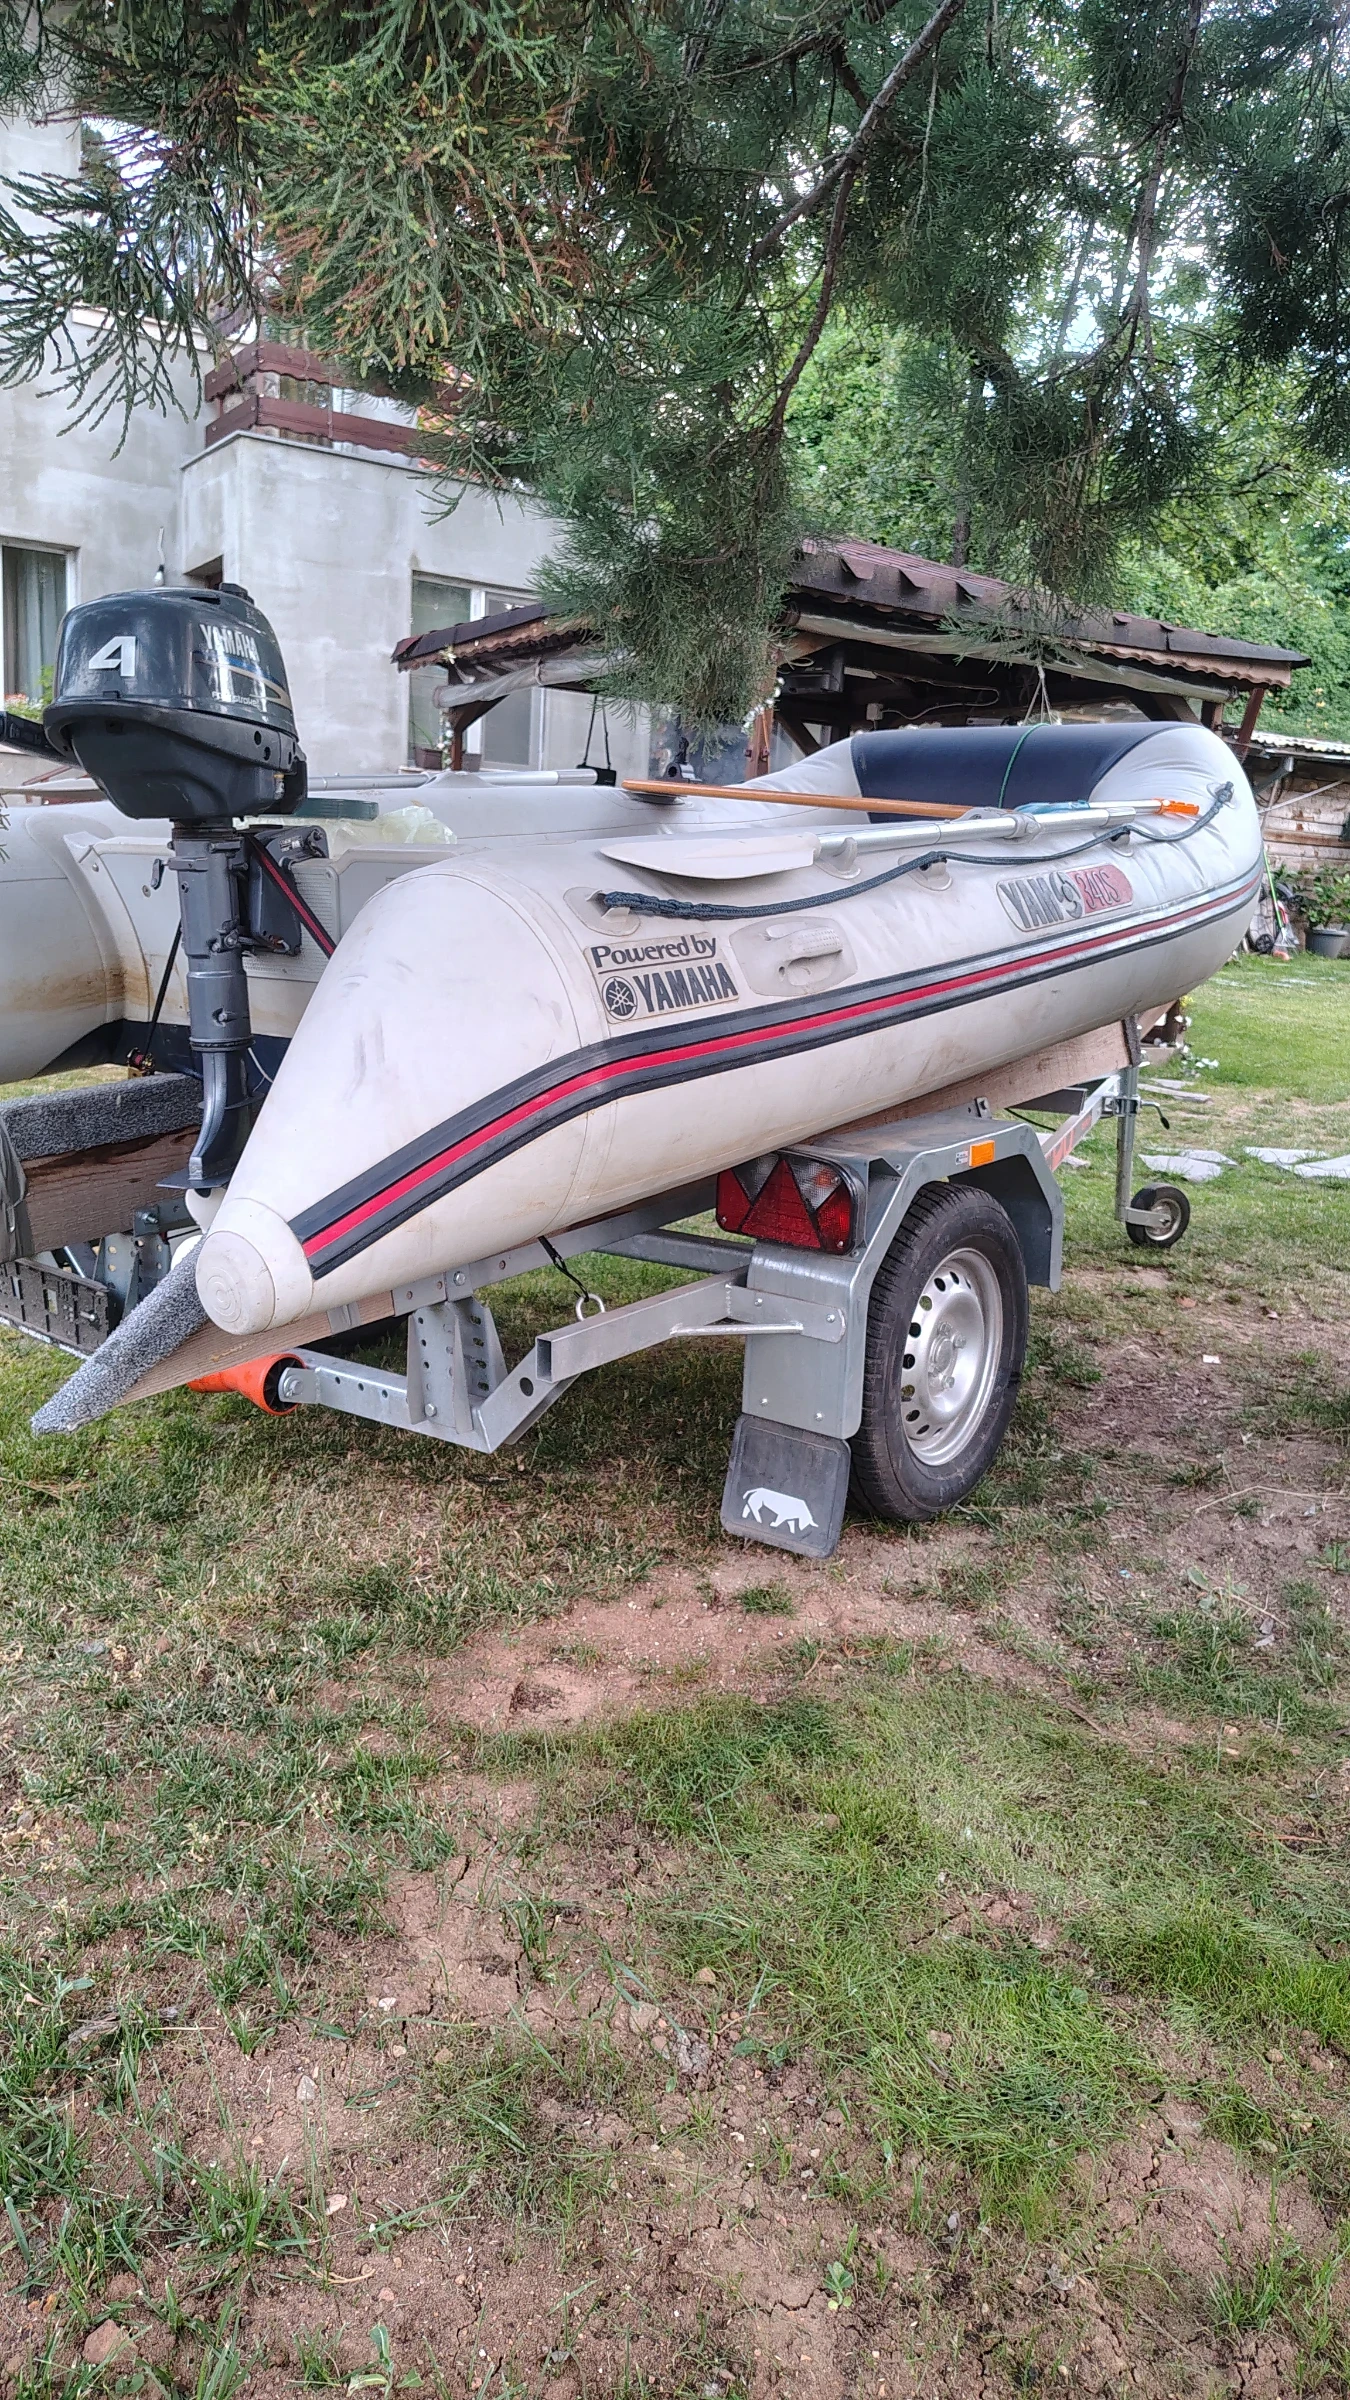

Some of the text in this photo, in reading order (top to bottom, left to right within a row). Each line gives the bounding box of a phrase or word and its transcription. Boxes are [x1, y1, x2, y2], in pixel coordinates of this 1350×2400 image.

[88, 636, 136, 677] 4
[199, 624, 260, 662] YAMAHA
[590, 934, 717, 968] Powered by
[632, 963, 738, 1012] YAMAHA
